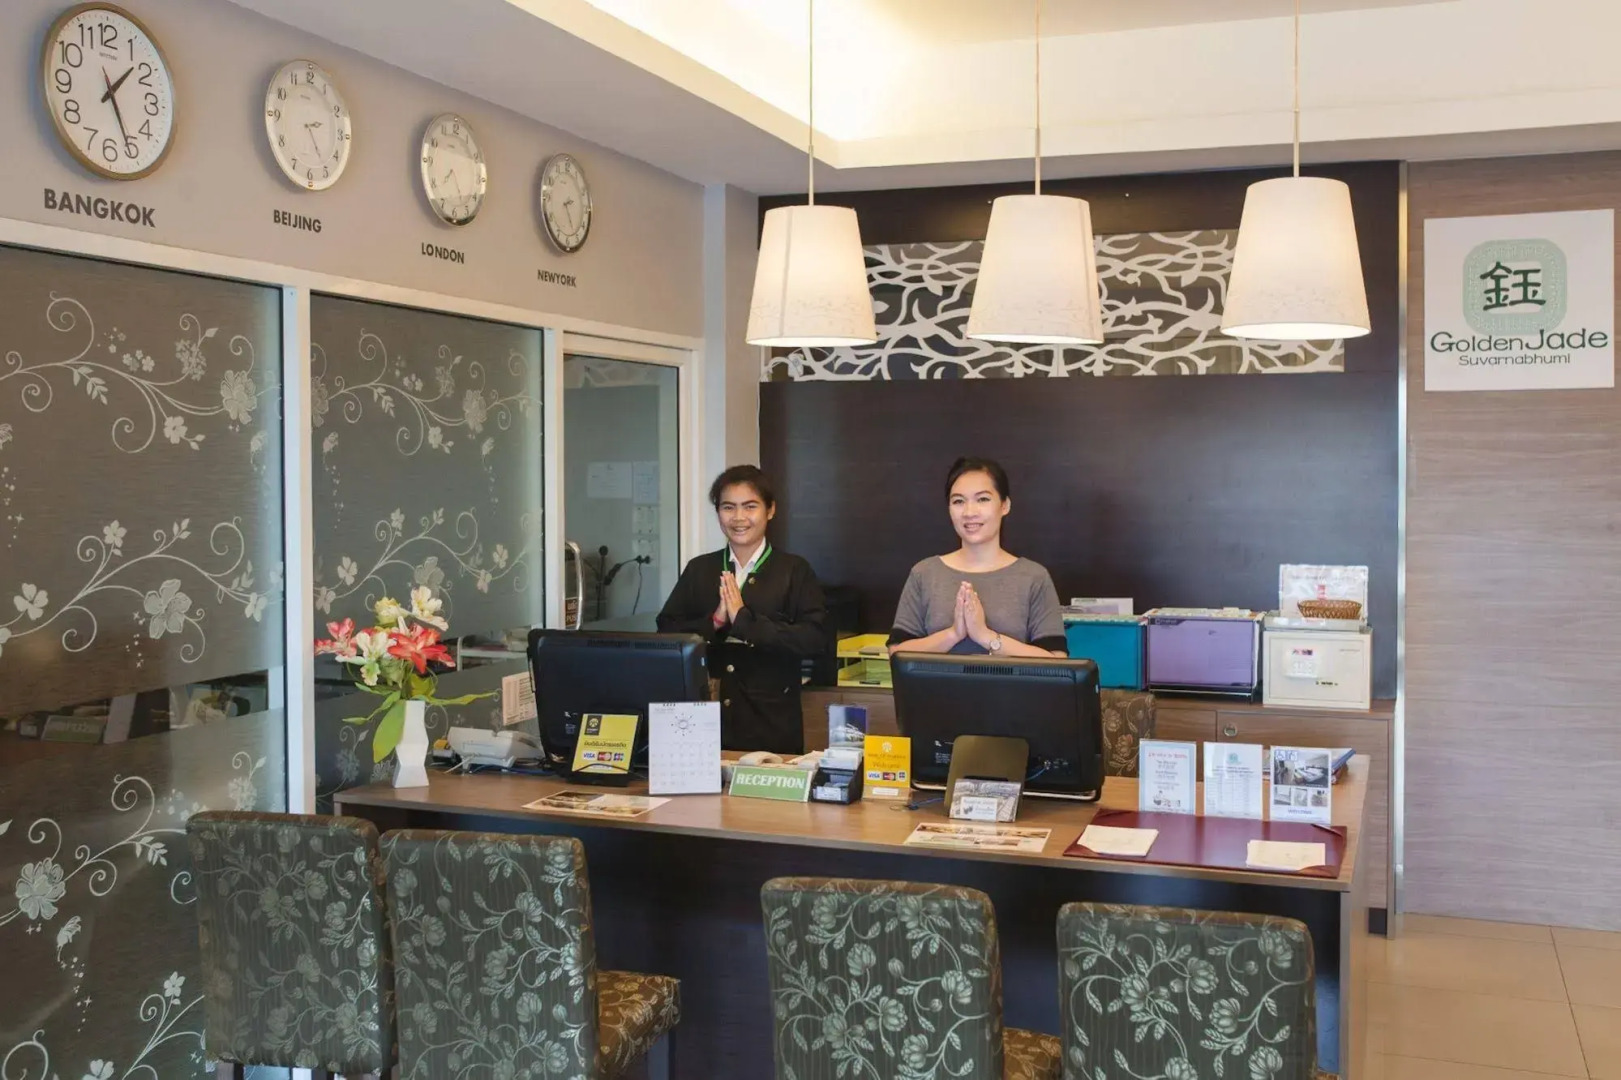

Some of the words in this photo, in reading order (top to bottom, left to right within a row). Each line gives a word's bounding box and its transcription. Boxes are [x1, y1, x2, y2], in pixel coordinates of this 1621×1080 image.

[78, 23, 94, 49] 11
[98, 22, 118, 51] 12
[59, 40, 83, 68] 10
[127, 38, 134, 62] 1
[55, 68, 72, 94] 9
[138, 62, 152, 87] 2
[290, 71, 298, 86] 11
[306, 71, 315, 85] 12
[144, 92, 159, 117] 3
[277, 87, 287, 101] 10
[64, 99, 81, 125] 8
[273, 108, 281, 122] 9
[333, 104, 340, 118] 2
[83, 126, 99, 151] 7
[138, 119, 153, 141] 4
[278, 135, 285, 148] 8
[336, 128, 344, 142] 3
[102, 138, 118, 162] 6
[124, 135, 139, 159] 5
[332, 149, 339, 162] 4
[291, 158, 297, 171] 7
[306, 167, 313, 181] 6
[322, 165, 329, 179] 5
[44, 188, 156, 228] BANGKOK
[273, 209, 322, 233] BEIJING
[421, 242, 465, 265] LONDON
[1479, 261, 1547, 311] 鈺
[1458, 353, 1571, 366] Suvarnabhumi
[736, 773, 805, 789] RECEPTION
